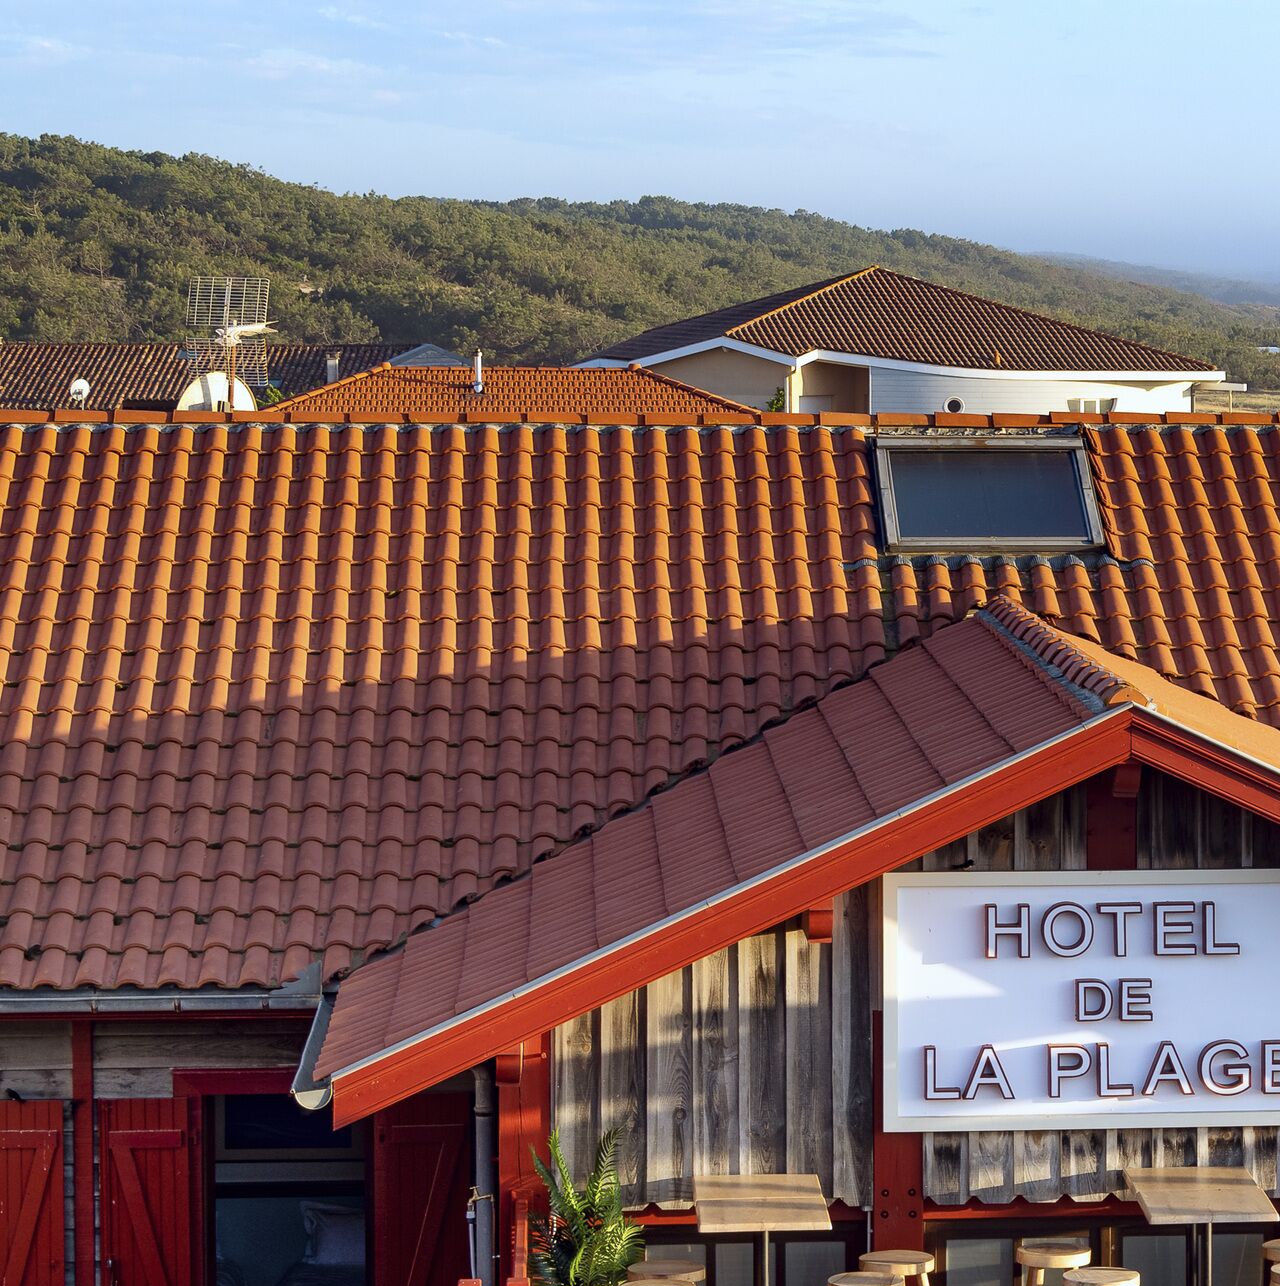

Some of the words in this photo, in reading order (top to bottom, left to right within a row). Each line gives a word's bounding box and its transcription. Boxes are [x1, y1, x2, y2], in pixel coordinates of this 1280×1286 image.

[984, 901, 1241, 959] HOTEL
[1074, 977, 1154, 1022] DE
[923, 1043, 1016, 1101] LA
